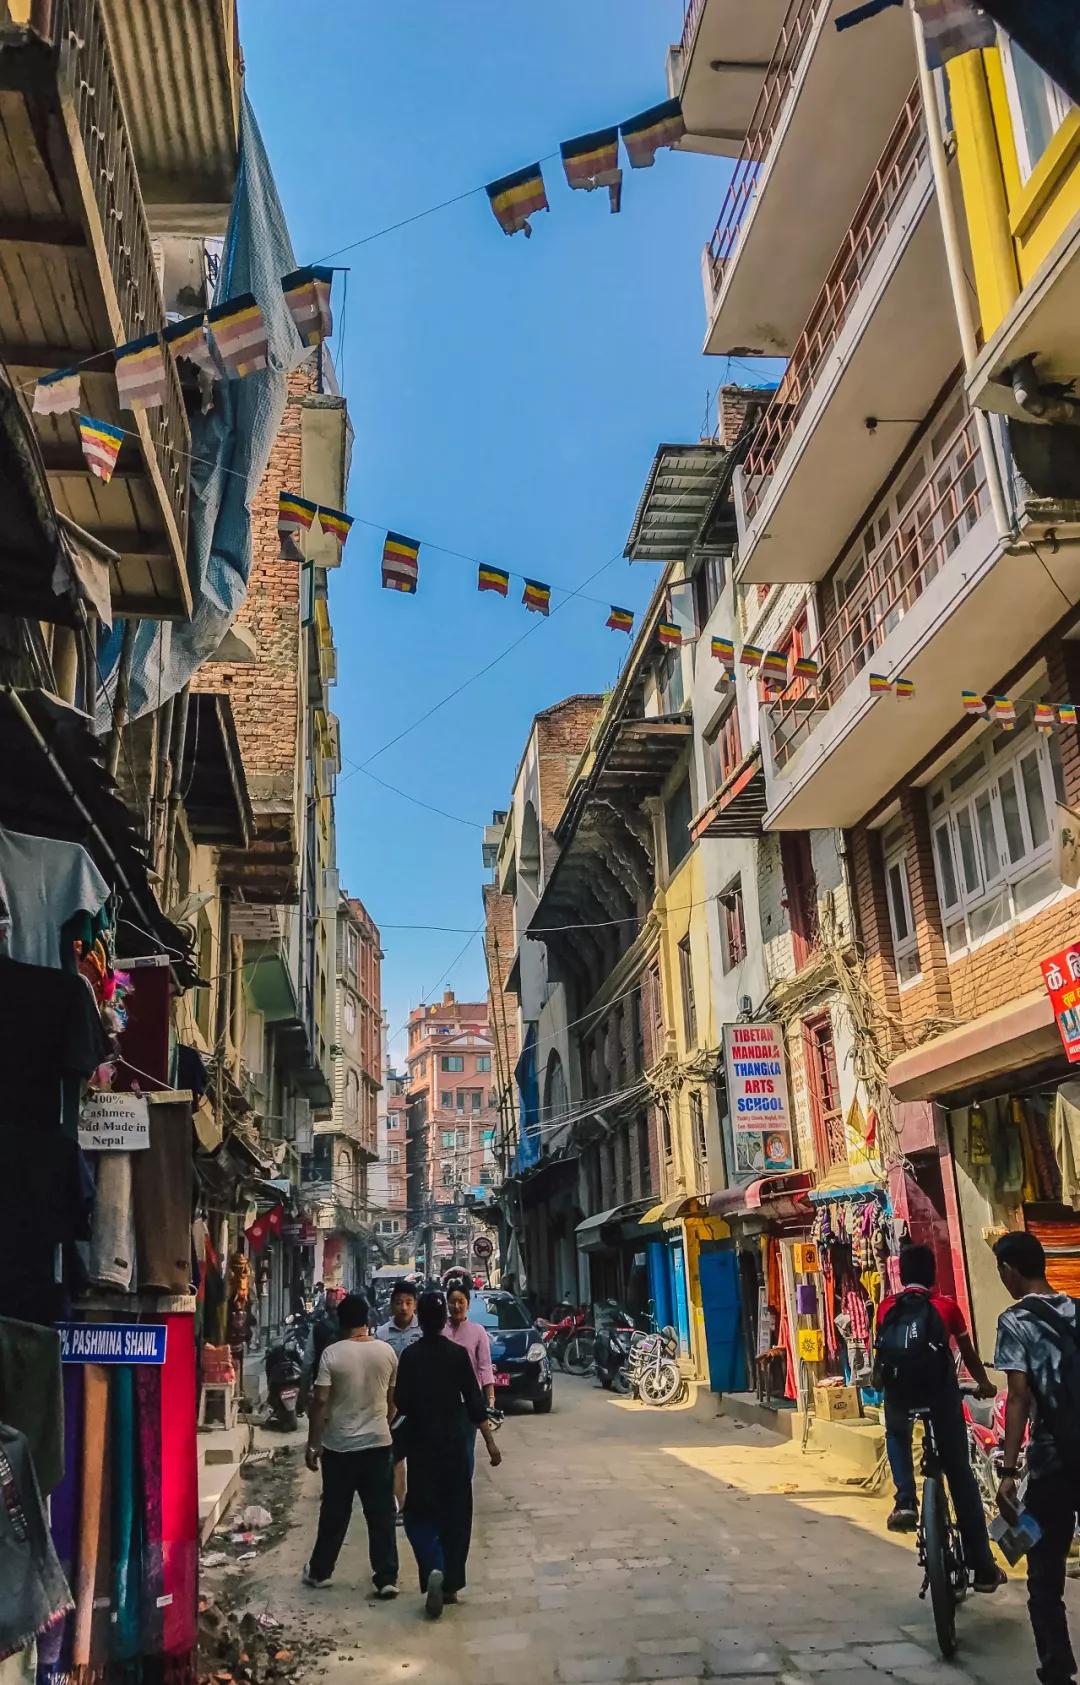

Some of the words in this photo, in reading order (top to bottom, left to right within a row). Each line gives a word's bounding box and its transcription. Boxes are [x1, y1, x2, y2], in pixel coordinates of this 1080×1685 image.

[733, 1028, 774, 1042] TIBETAN
[732, 1045, 780, 1059] MANDALA
[733, 1061, 782, 1077] THANGKA
[745, 1079, 774, 1093] ARTS
[93, 1095, 124, 1104] 100%
[737, 1097, 784, 1112] SCHOOL
[81, 1108, 136, 1118] Cashmere
[103, 1121, 134, 1132] Made
[136, 1123, 146, 1132] in
[92, 1136, 124, 1147] Nepal
[72, 1330, 122, 1355] PASHMINA
[124, 1331, 157, 1356] SHAWL
